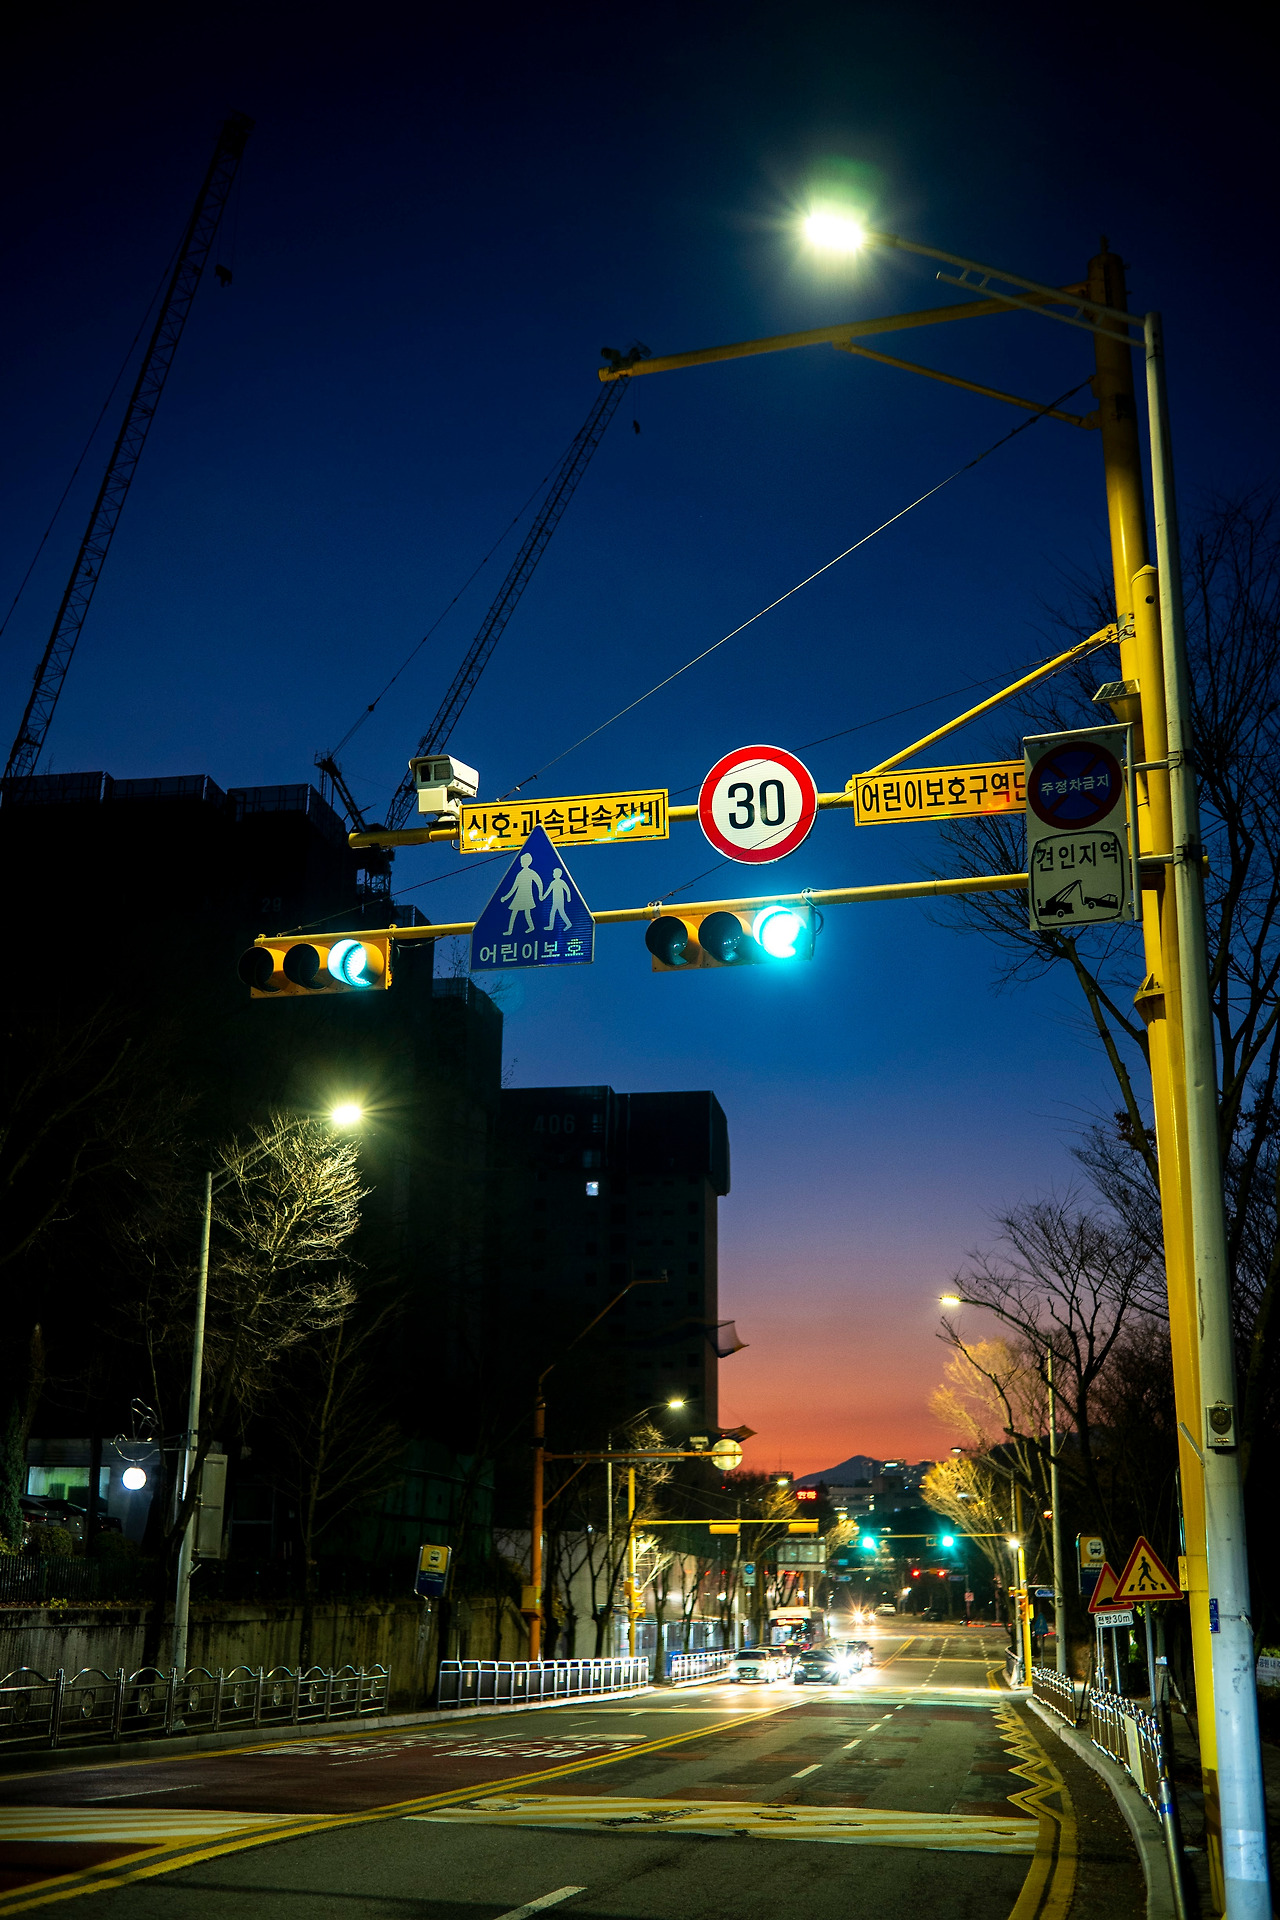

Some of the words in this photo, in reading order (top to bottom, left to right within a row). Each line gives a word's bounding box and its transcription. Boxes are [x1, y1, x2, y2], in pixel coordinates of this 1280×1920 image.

[1041, 774, 1109, 796] 주정차금지
[727, 779, 785, 829] 30
[1036, 839, 1118, 872] 견인지역
[479, 938, 584, 963] 어린이보호
[533, 1113, 576, 1135] 406
[1097, 1614, 1130, 1625] 전방30m
